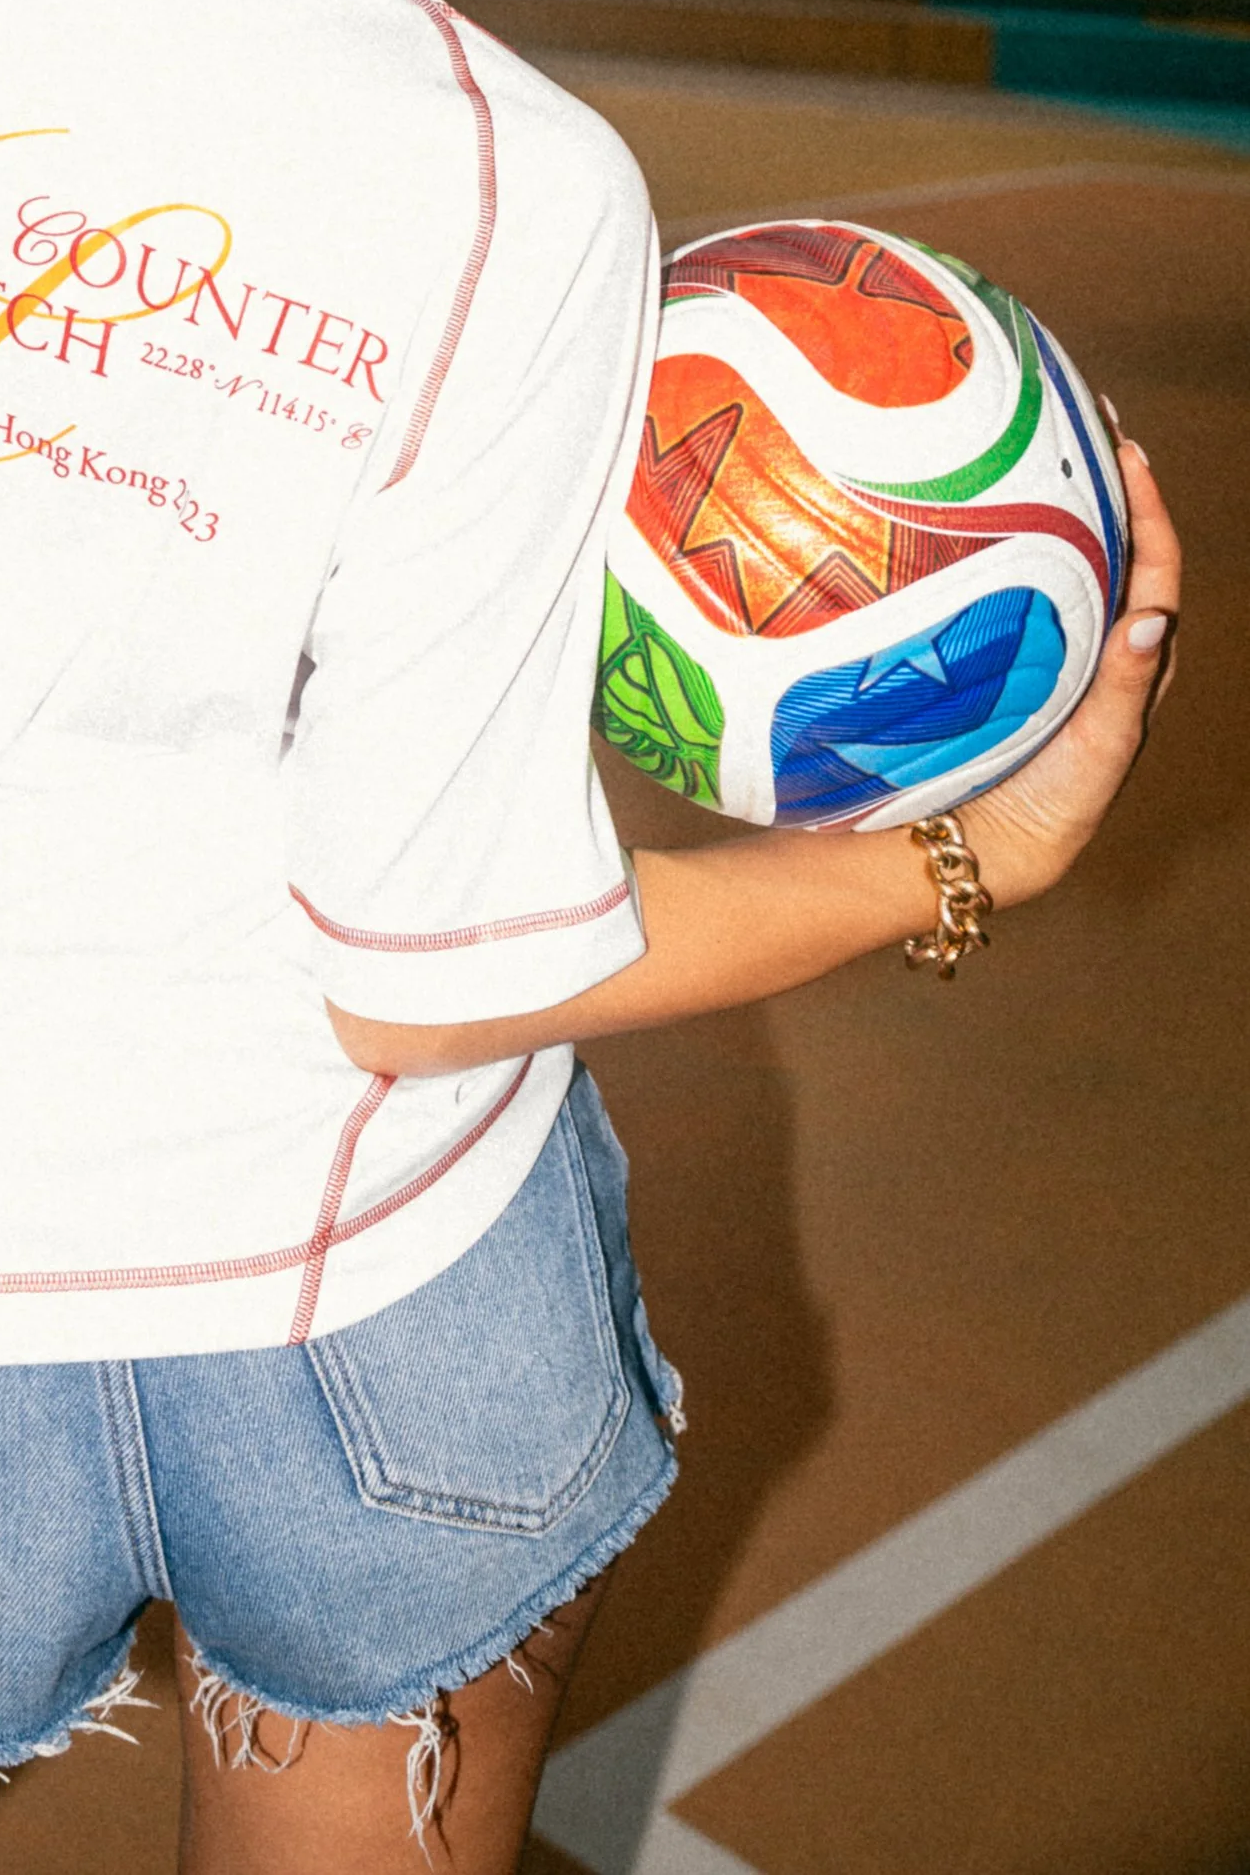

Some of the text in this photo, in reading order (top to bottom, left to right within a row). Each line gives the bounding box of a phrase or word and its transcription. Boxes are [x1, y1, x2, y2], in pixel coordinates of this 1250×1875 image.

[13, 195, 389, 403] COUNTER
[78, 446, 171, 508] Kong
[173, 478, 220, 543] 223
